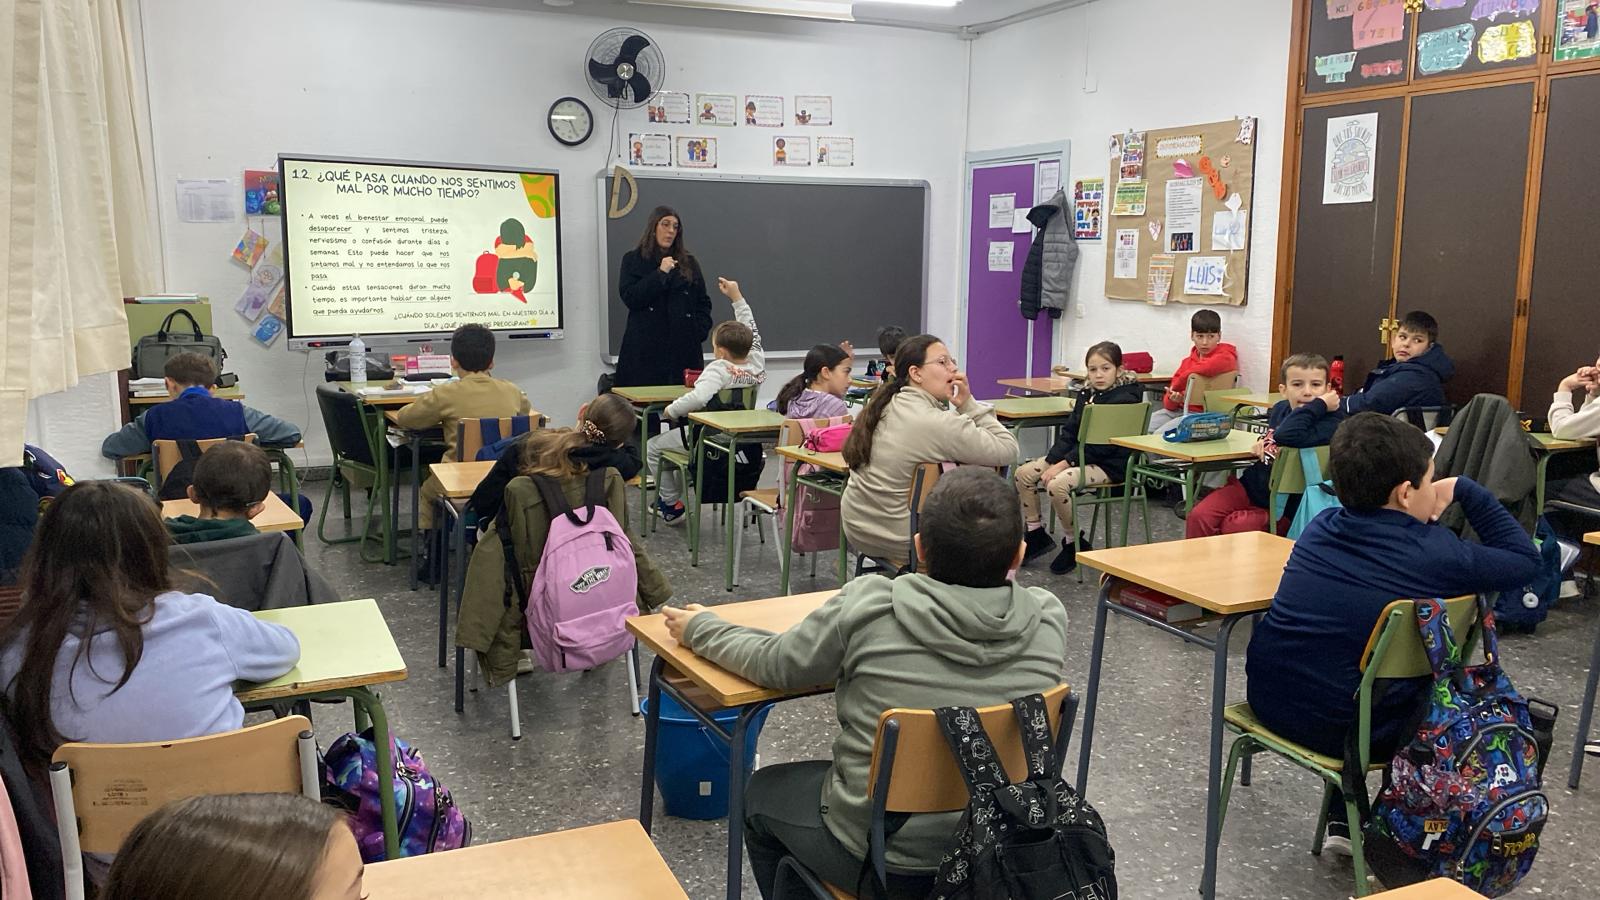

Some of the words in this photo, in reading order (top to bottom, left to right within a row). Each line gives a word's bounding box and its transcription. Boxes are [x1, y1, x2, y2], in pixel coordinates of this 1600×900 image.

[317, 169, 350, 183] ¿QUÉ
[355, 172, 386, 184] PASA
[391, 174, 437, 185] CUANDO
[441, 177, 463, 187] NOS
[467, 178, 516, 190] SENTIMOS
[336, 184, 362, 194] MAL
[367, 184, 389, 195] POR
[393, 186, 433, 197] MUCHO
[438, 188, 480, 199] TIEMPO?
[309, 225, 352, 233] desaparecer
[370, 249, 389, 257] puede
[312, 308, 325, 316] que
[327, 307, 348, 315] pueda
